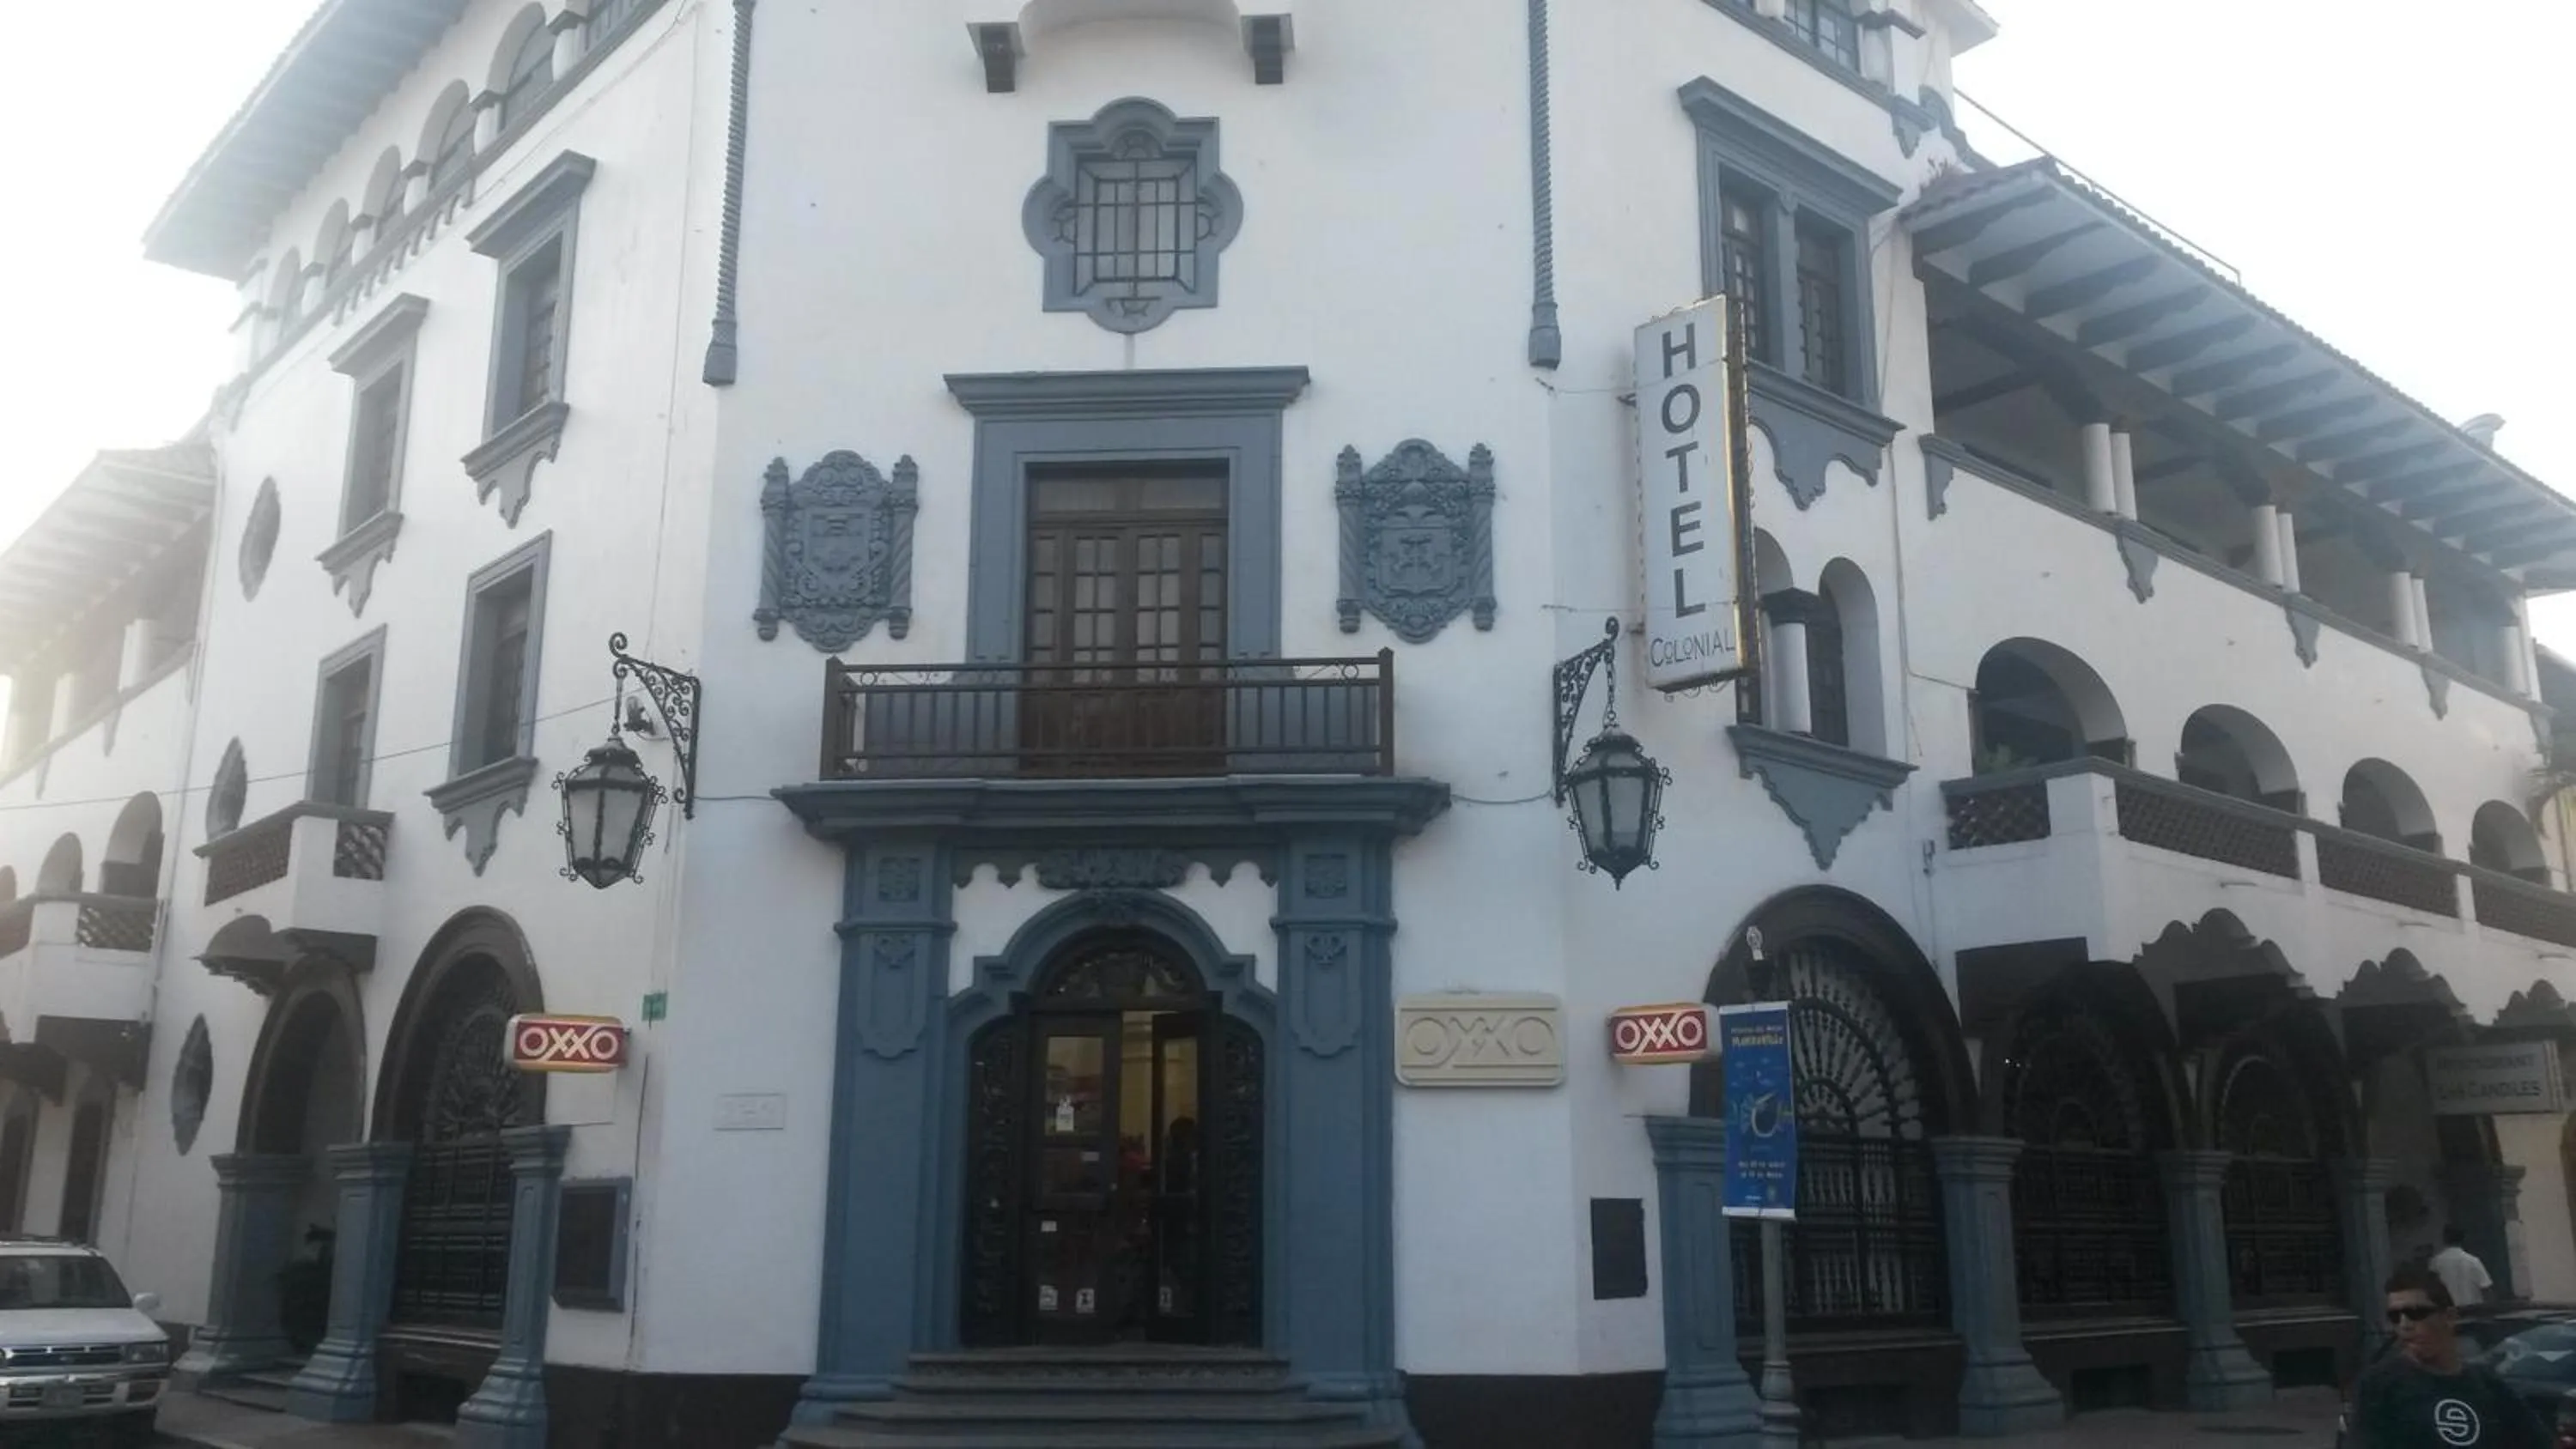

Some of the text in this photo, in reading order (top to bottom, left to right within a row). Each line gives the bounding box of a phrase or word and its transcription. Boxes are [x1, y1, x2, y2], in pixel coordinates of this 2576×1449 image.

[1661, 323, 1706, 620] HOTEL
[1650, 629, 1735, 667] COLONIAL
[519, 1024, 619, 1062] OXXO
[1406, 1016, 1556, 1065] OXXO
[1614, 1012, 1704, 1056] OXXO
